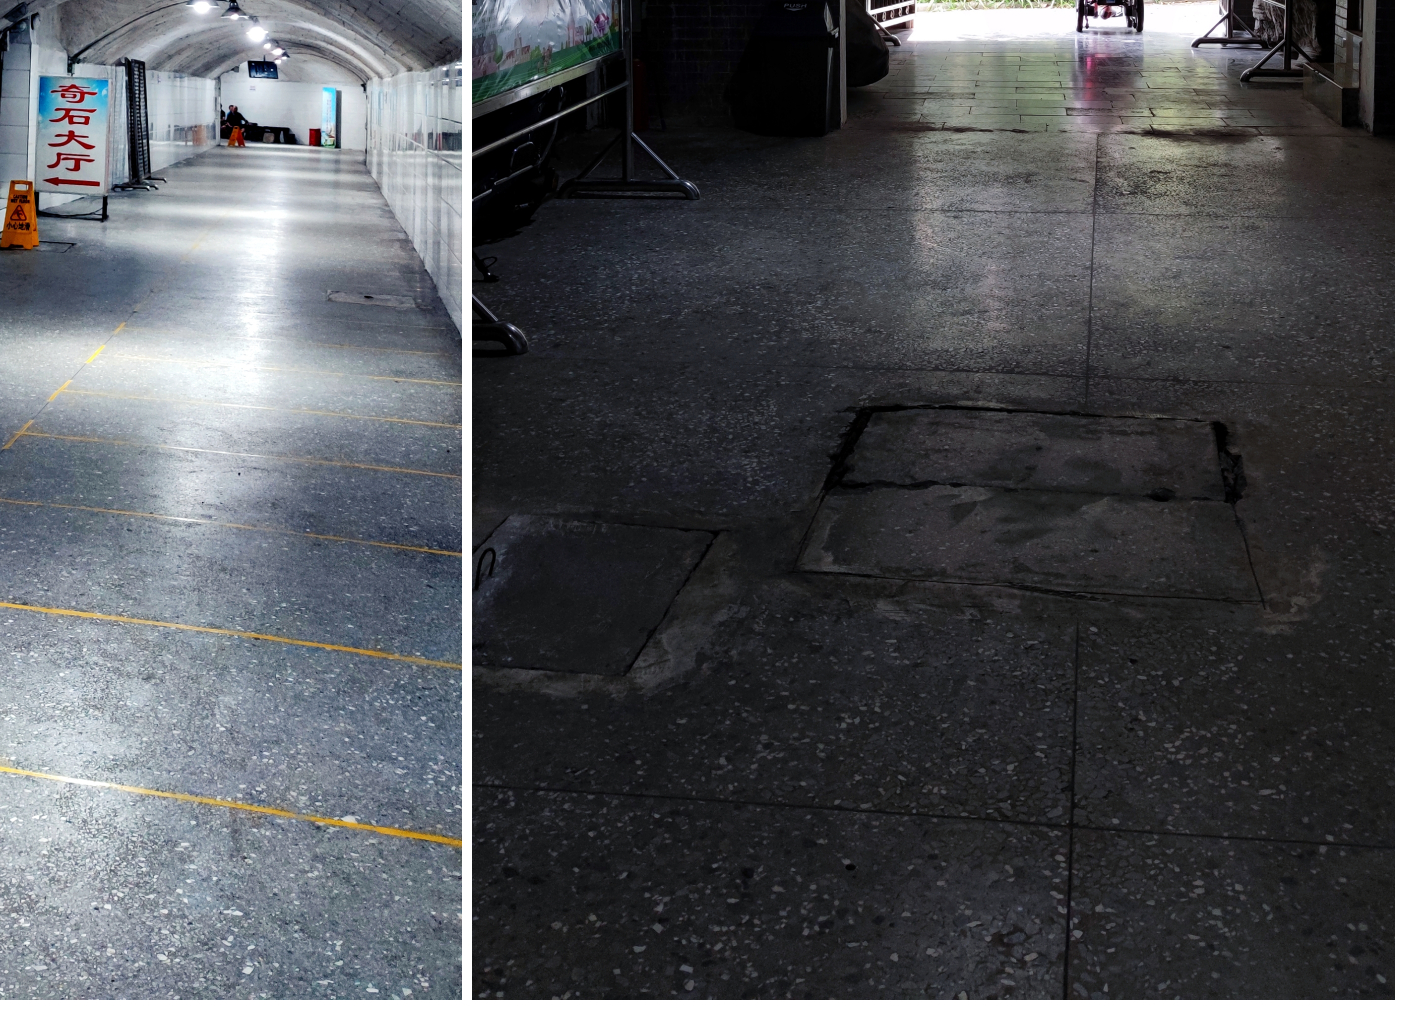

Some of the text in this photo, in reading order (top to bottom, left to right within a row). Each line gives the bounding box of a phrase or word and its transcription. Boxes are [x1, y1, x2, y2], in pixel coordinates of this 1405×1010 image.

[47, 84, 98, 172] 奇石大厅
[6, 221, 31, 231] 小心地滑
